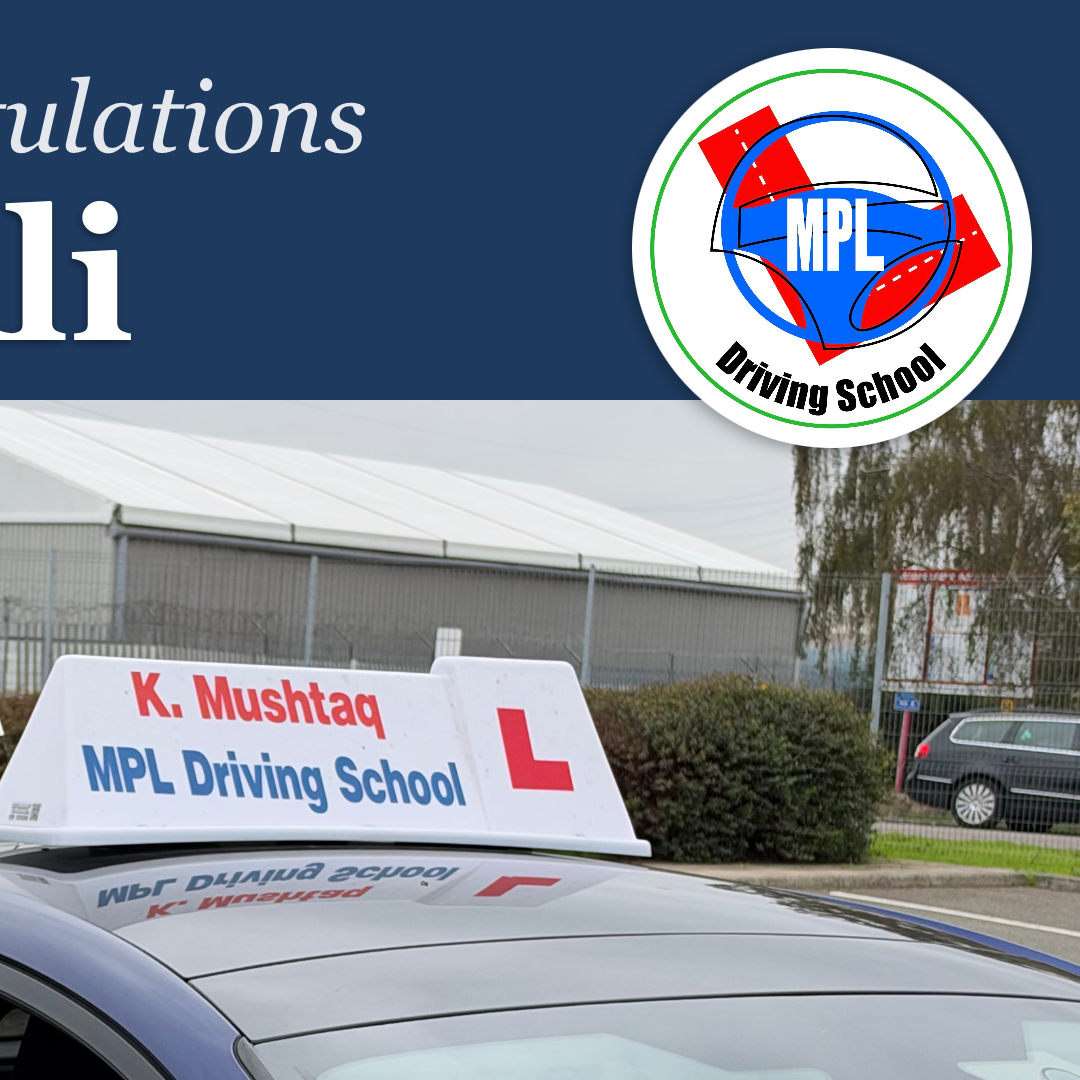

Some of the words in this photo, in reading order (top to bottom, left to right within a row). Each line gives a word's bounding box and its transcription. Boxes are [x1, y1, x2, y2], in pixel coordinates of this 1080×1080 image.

[131, 672, 183, 718] K.
[193, 675, 386, 740] Mushtaq
[82, 745, 174, 795] MPL
[181, 750, 328, 814] Driving
[335, 756, 467, 807] School
[496, 708, 575, 792] L
